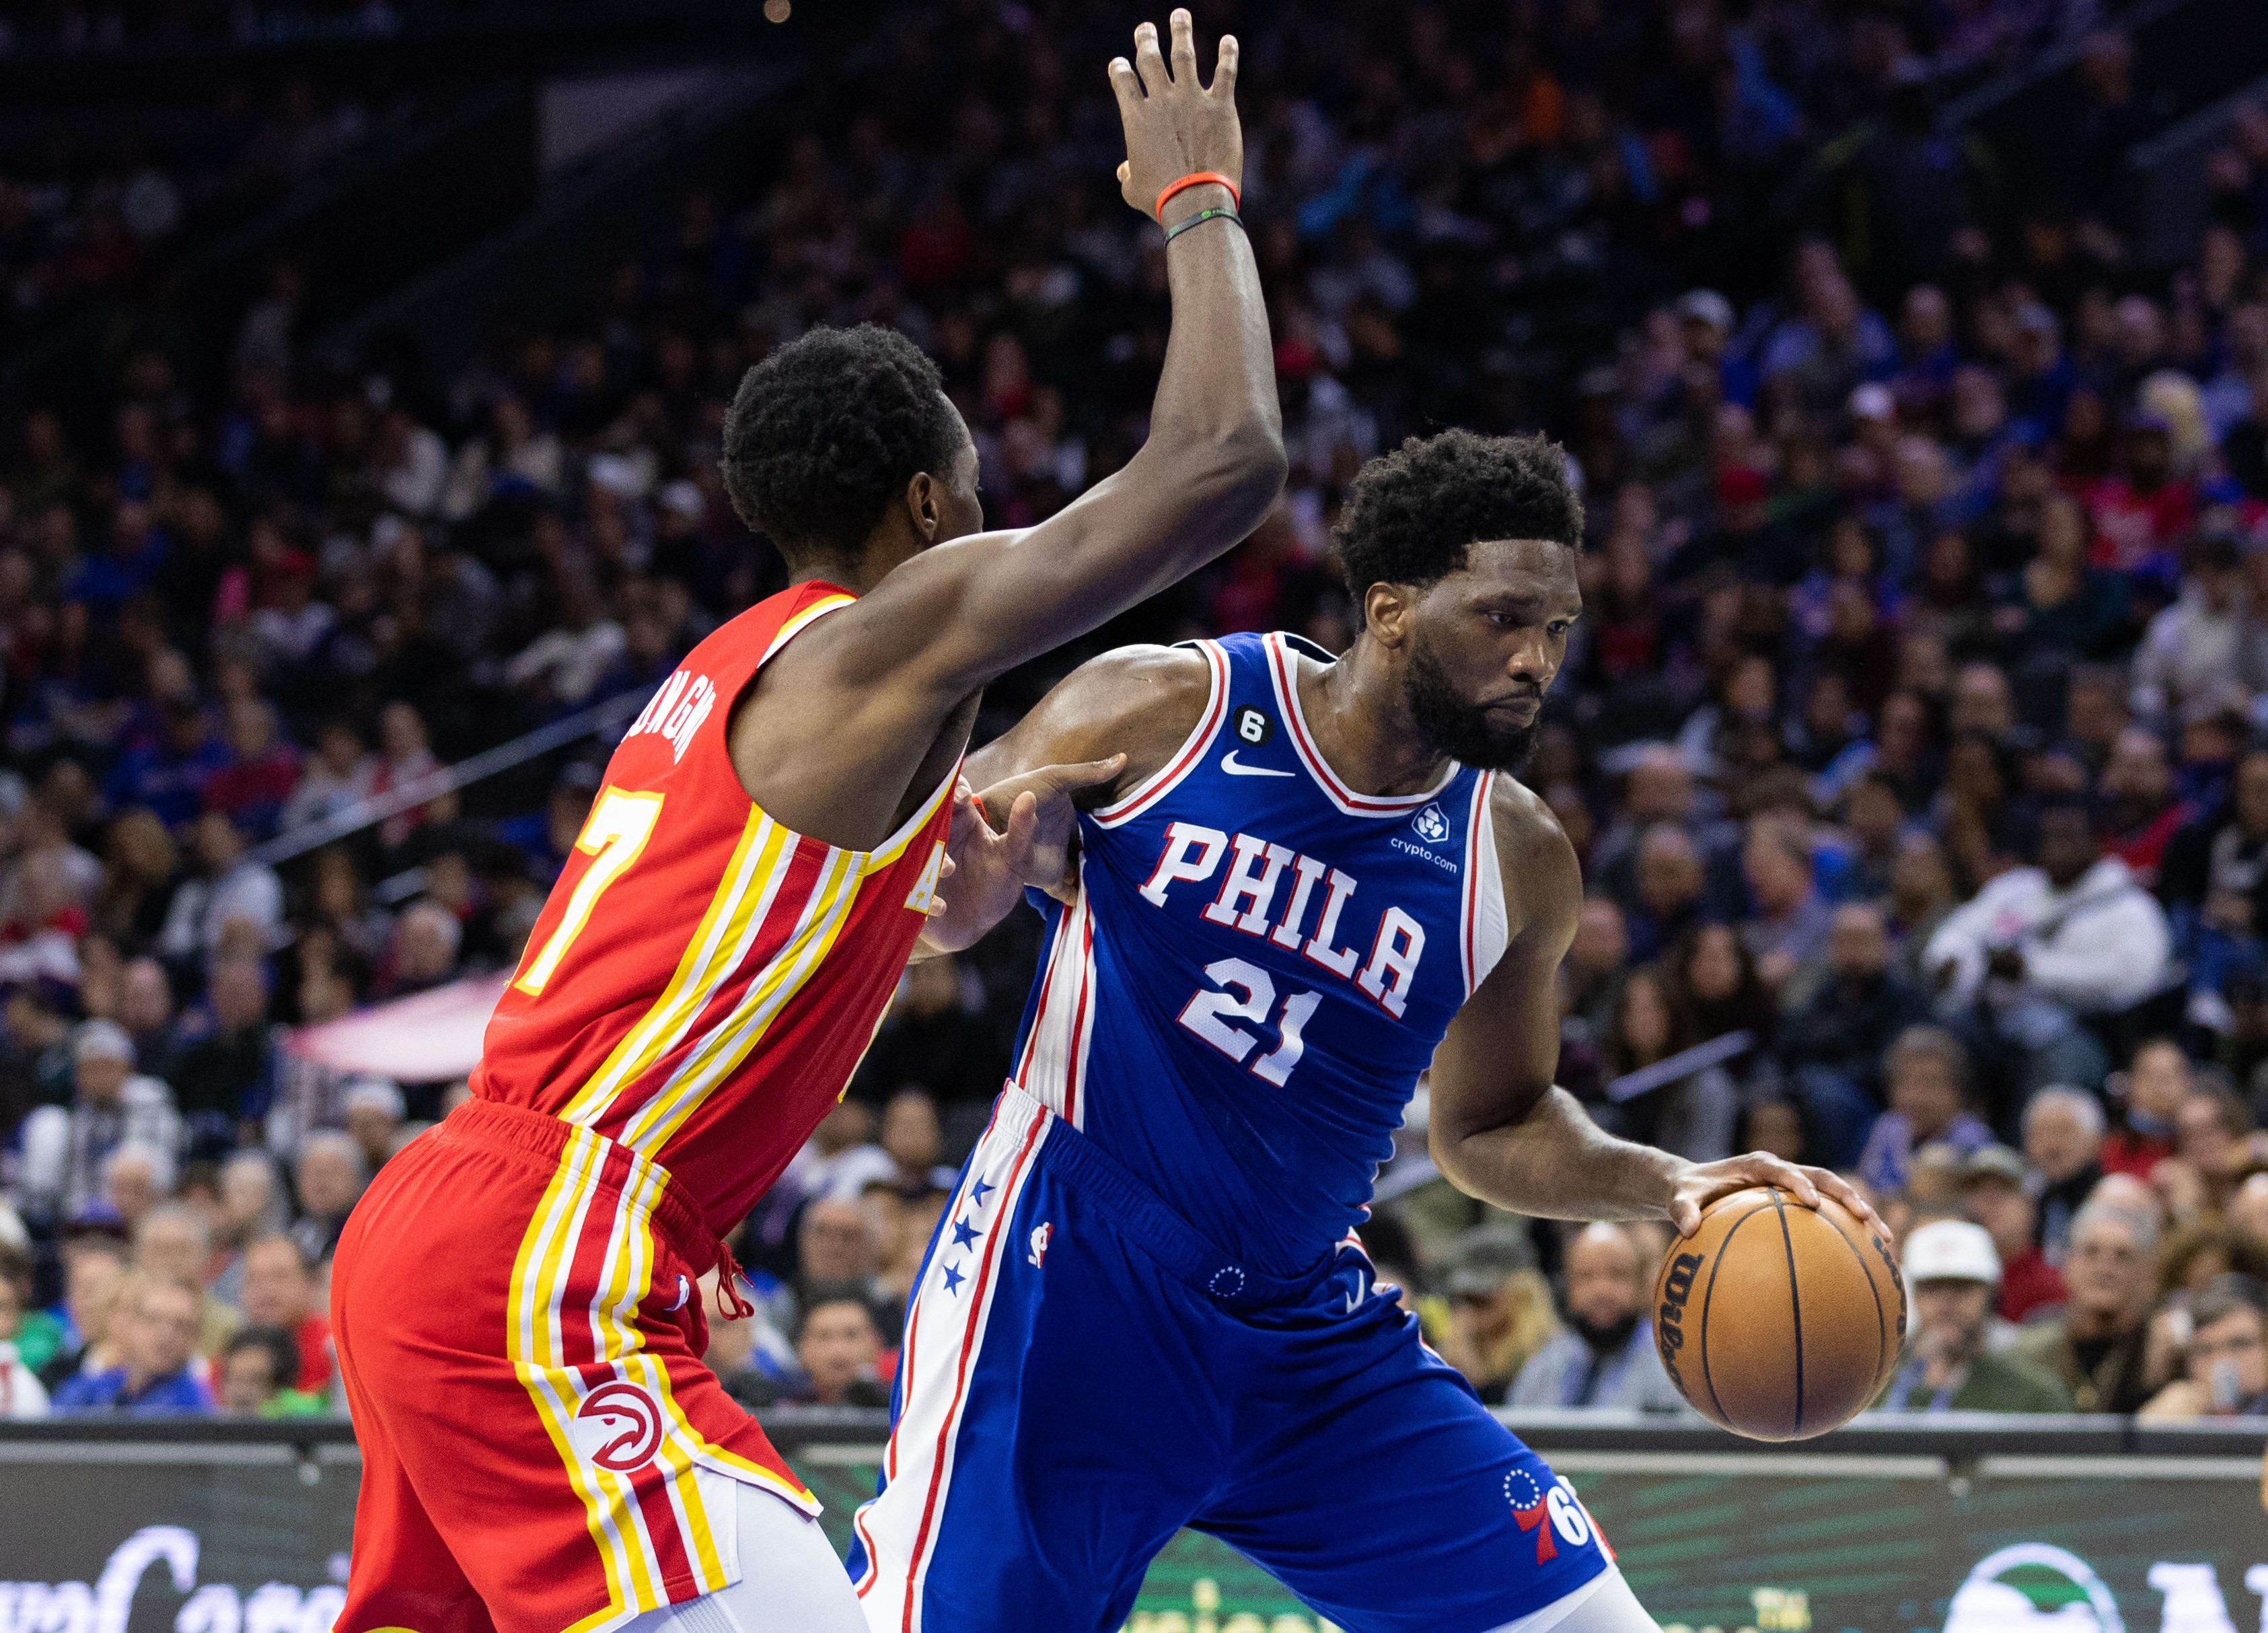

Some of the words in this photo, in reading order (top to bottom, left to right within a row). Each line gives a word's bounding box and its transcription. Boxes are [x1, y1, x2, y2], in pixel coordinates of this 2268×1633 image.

[1240, 710, 1265, 743] 6
[1391, 838, 1458, 873] crypto.com
[1137, 822, 1426, 1020] PHILA
[1175, 957, 1323, 1089] 21
[1512, 1486, 1589, 1566] 76
